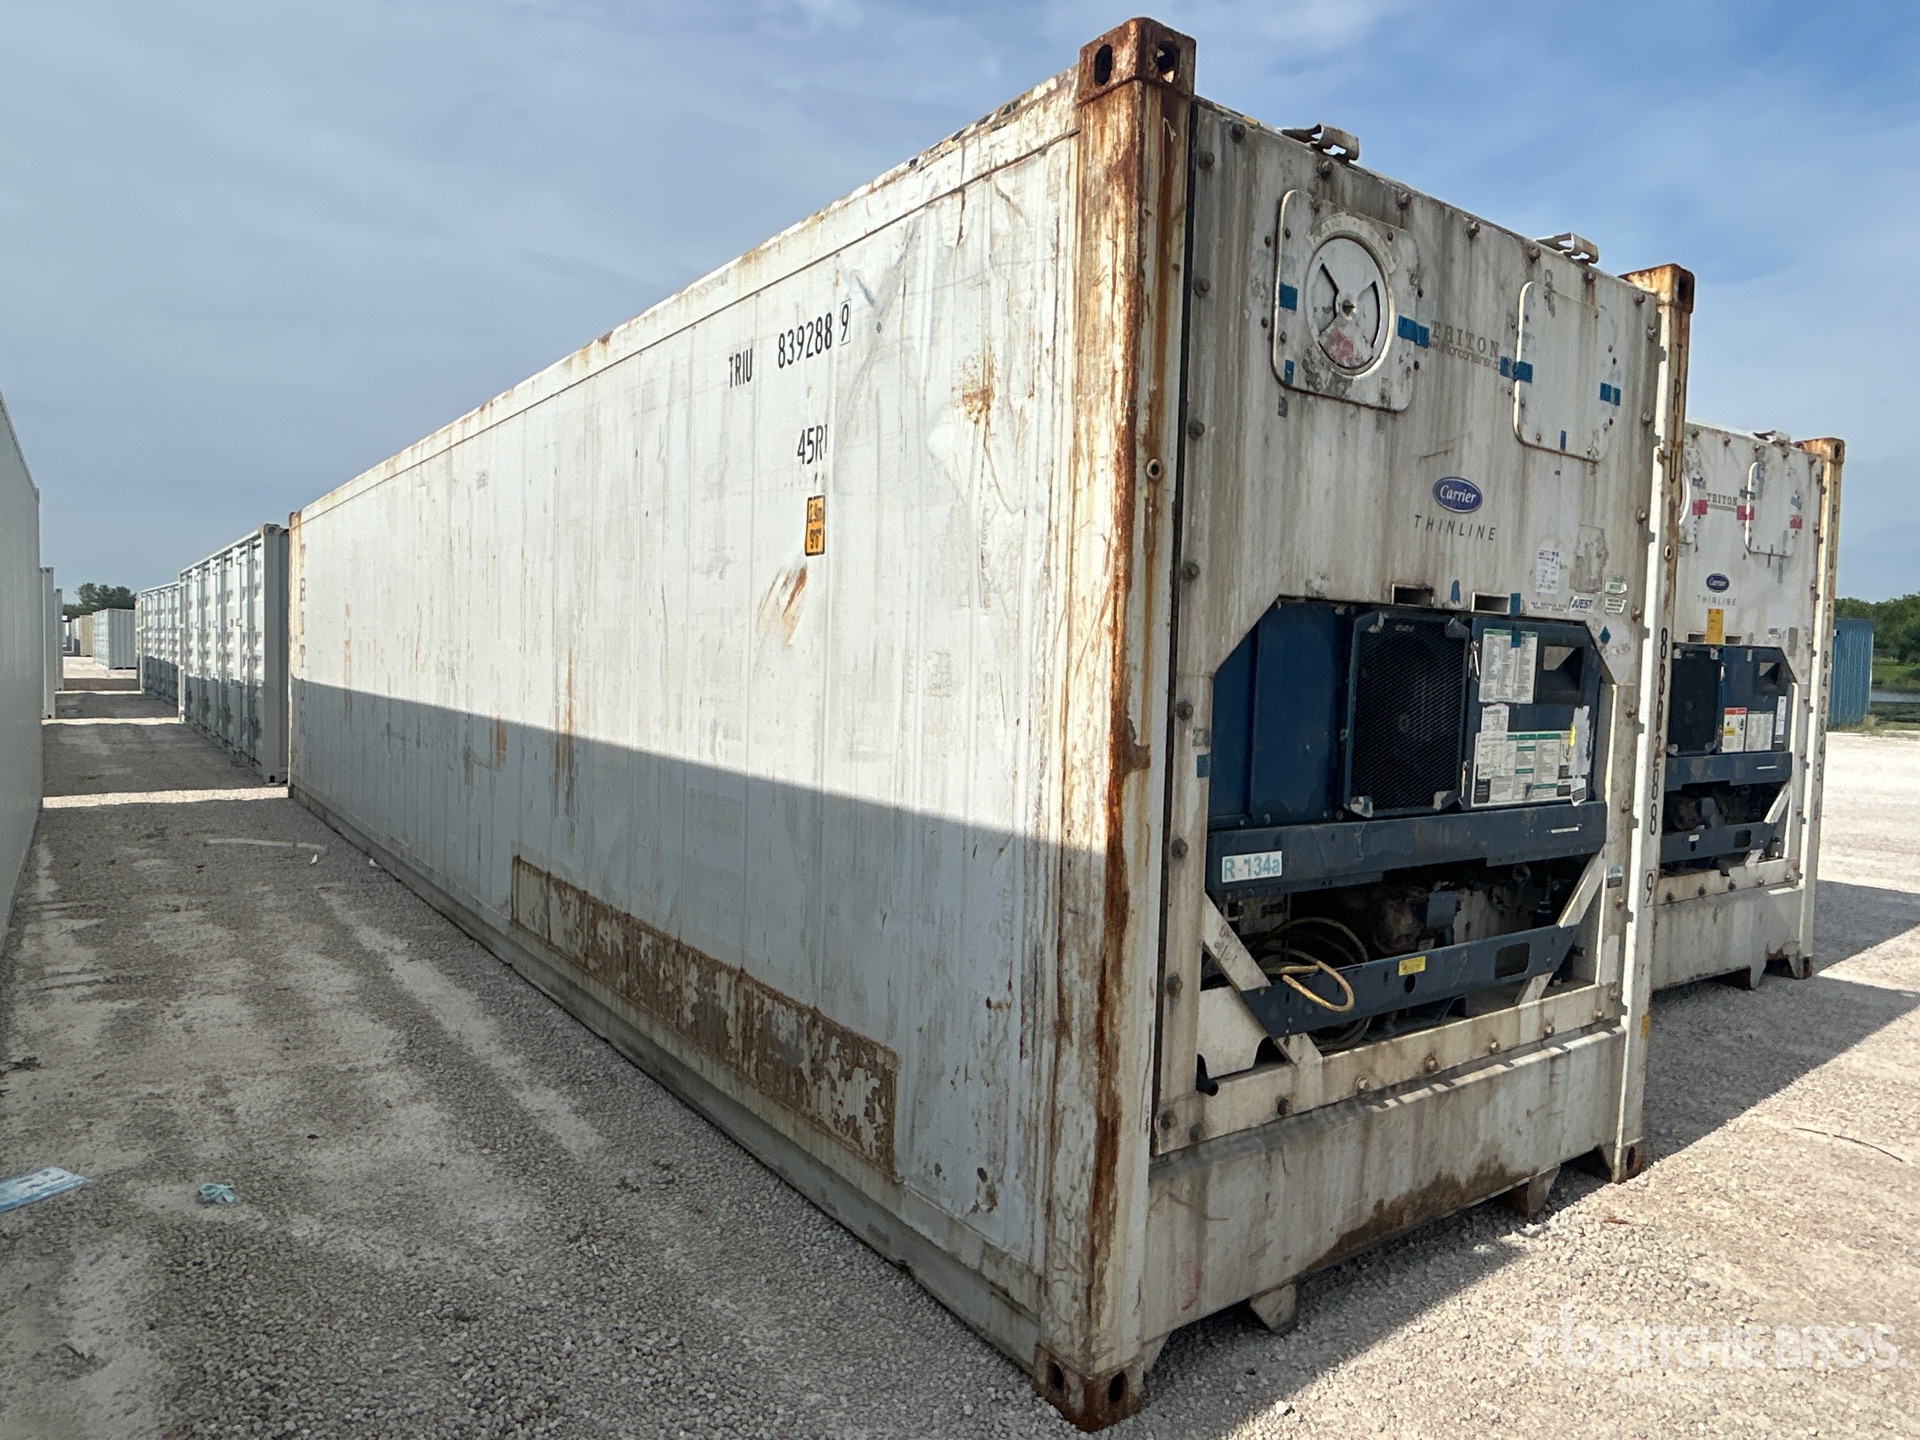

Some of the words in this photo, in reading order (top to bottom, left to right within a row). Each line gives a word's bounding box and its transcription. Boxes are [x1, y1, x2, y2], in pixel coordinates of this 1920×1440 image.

[728, 347, 753, 388] TRIU
[778, 312, 833, 369] 839288
[841, 303, 849, 342] 9
[1431, 320, 1500, 358] TRITON
[797, 423, 828, 465] 45R1
[1439, 484, 1477, 504] Carrier
[1706, 492, 1738, 506] TRITON
[1414, 514, 1497, 541] THINLINE
[1696, 595, 1737, 607] THINLINE
[1645, 872, 1654, 904] 9
